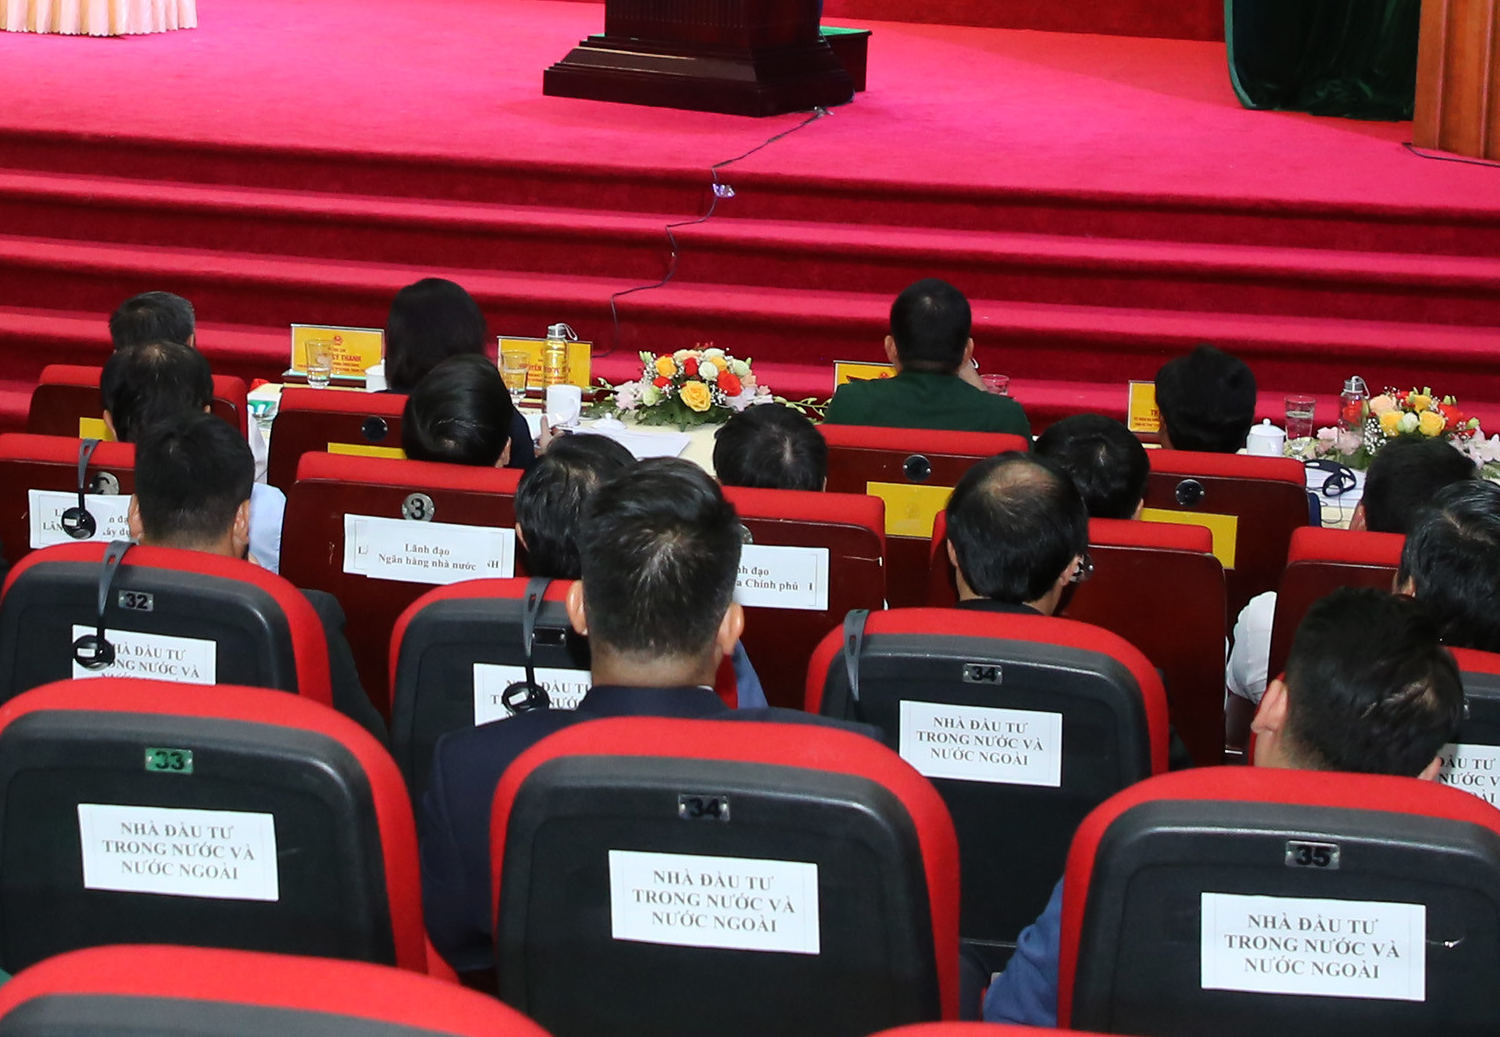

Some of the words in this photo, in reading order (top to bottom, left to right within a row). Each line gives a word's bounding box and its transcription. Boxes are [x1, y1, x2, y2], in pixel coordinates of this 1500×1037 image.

[411, 498, 425, 520] 3
[405, 543, 429, 554] Lãnh
[433, 546, 450, 557] đạo
[379, 553, 402, 564] Ngân
[406, 556, 429, 568] hàng
[432, 559, 450, 569] nhà
[452, 560, 477, 571] nước
[751, 566, 770, 578] đạo
[746, 578, 776, 589] Chính
[780, 581, 798, 592] phủ
[126, 593, 148, 610] 32
[112, 641, 130, 656] HÀ
[167, 649, 186, 662] TƯ
[139, 661, 178, 676] NƯỚC
[182, 664, 200, 678] VÀ
[972, 666, 996, 682] 34
[934, 716, 965, 730] NHÀ
[970, 718, 1000, 732] ĐẦU
[1006, 722, 1028, 734] TƯ
[916, 731, 970, 745] TRONG
[974, 735, 1018, 749] NƯỚC
[1023, 738, 1044, 752] VÀ
[155, 750, 185, 770] 33
[930, 747, 974, 762] NƯỚC
[979, 751, 1028, 766] NGOÀI
[1472, 758, 1496, 770] TƯ
[688, 798, 721, 818] 34
[120, 820, 158, 836] NHÀ
[164, 822, 202, 838] ĐẦU
[207, 825, 234, 840] TƯ
[102, 840, 167, 856] TRONG
[172, 842, 226, 859] NƯỚC
[230, 844, 255, 861] VÀ
[1294, 844, 1331, 867] 35
[122, 860, 174, 876] NƯỚC
[180, 862, 238, 880] NGOÀI
[653, 868, 694, 886] NHÀ
[700, 870, 740, 889] ĐẦU
[746, 875, 774, 891] TƯ
[632, 888, 700, 907] TRONG
[706, 892, 763, 912] NƯỚC
[768, 895, 795, 914] VÀ
[652, 910, 708, 928] NƯỚC
[713, 914, 777, 933] NGOÀI
[1248, 912, 1292, 930] NHÀ
[1298, 914, 1342, 934] ĐẦU
[1348, 918, 1378, 936] TƯ
[1224, 934, 1298, 952] TRONG
[1304, 936, 1365, 956] NƯỚC
[1372, 940, 1400, 958] VÀ
[1244, 956, 1305, 975] NƯỚC
[1311, 960, 1380, 980] NGOÀI
